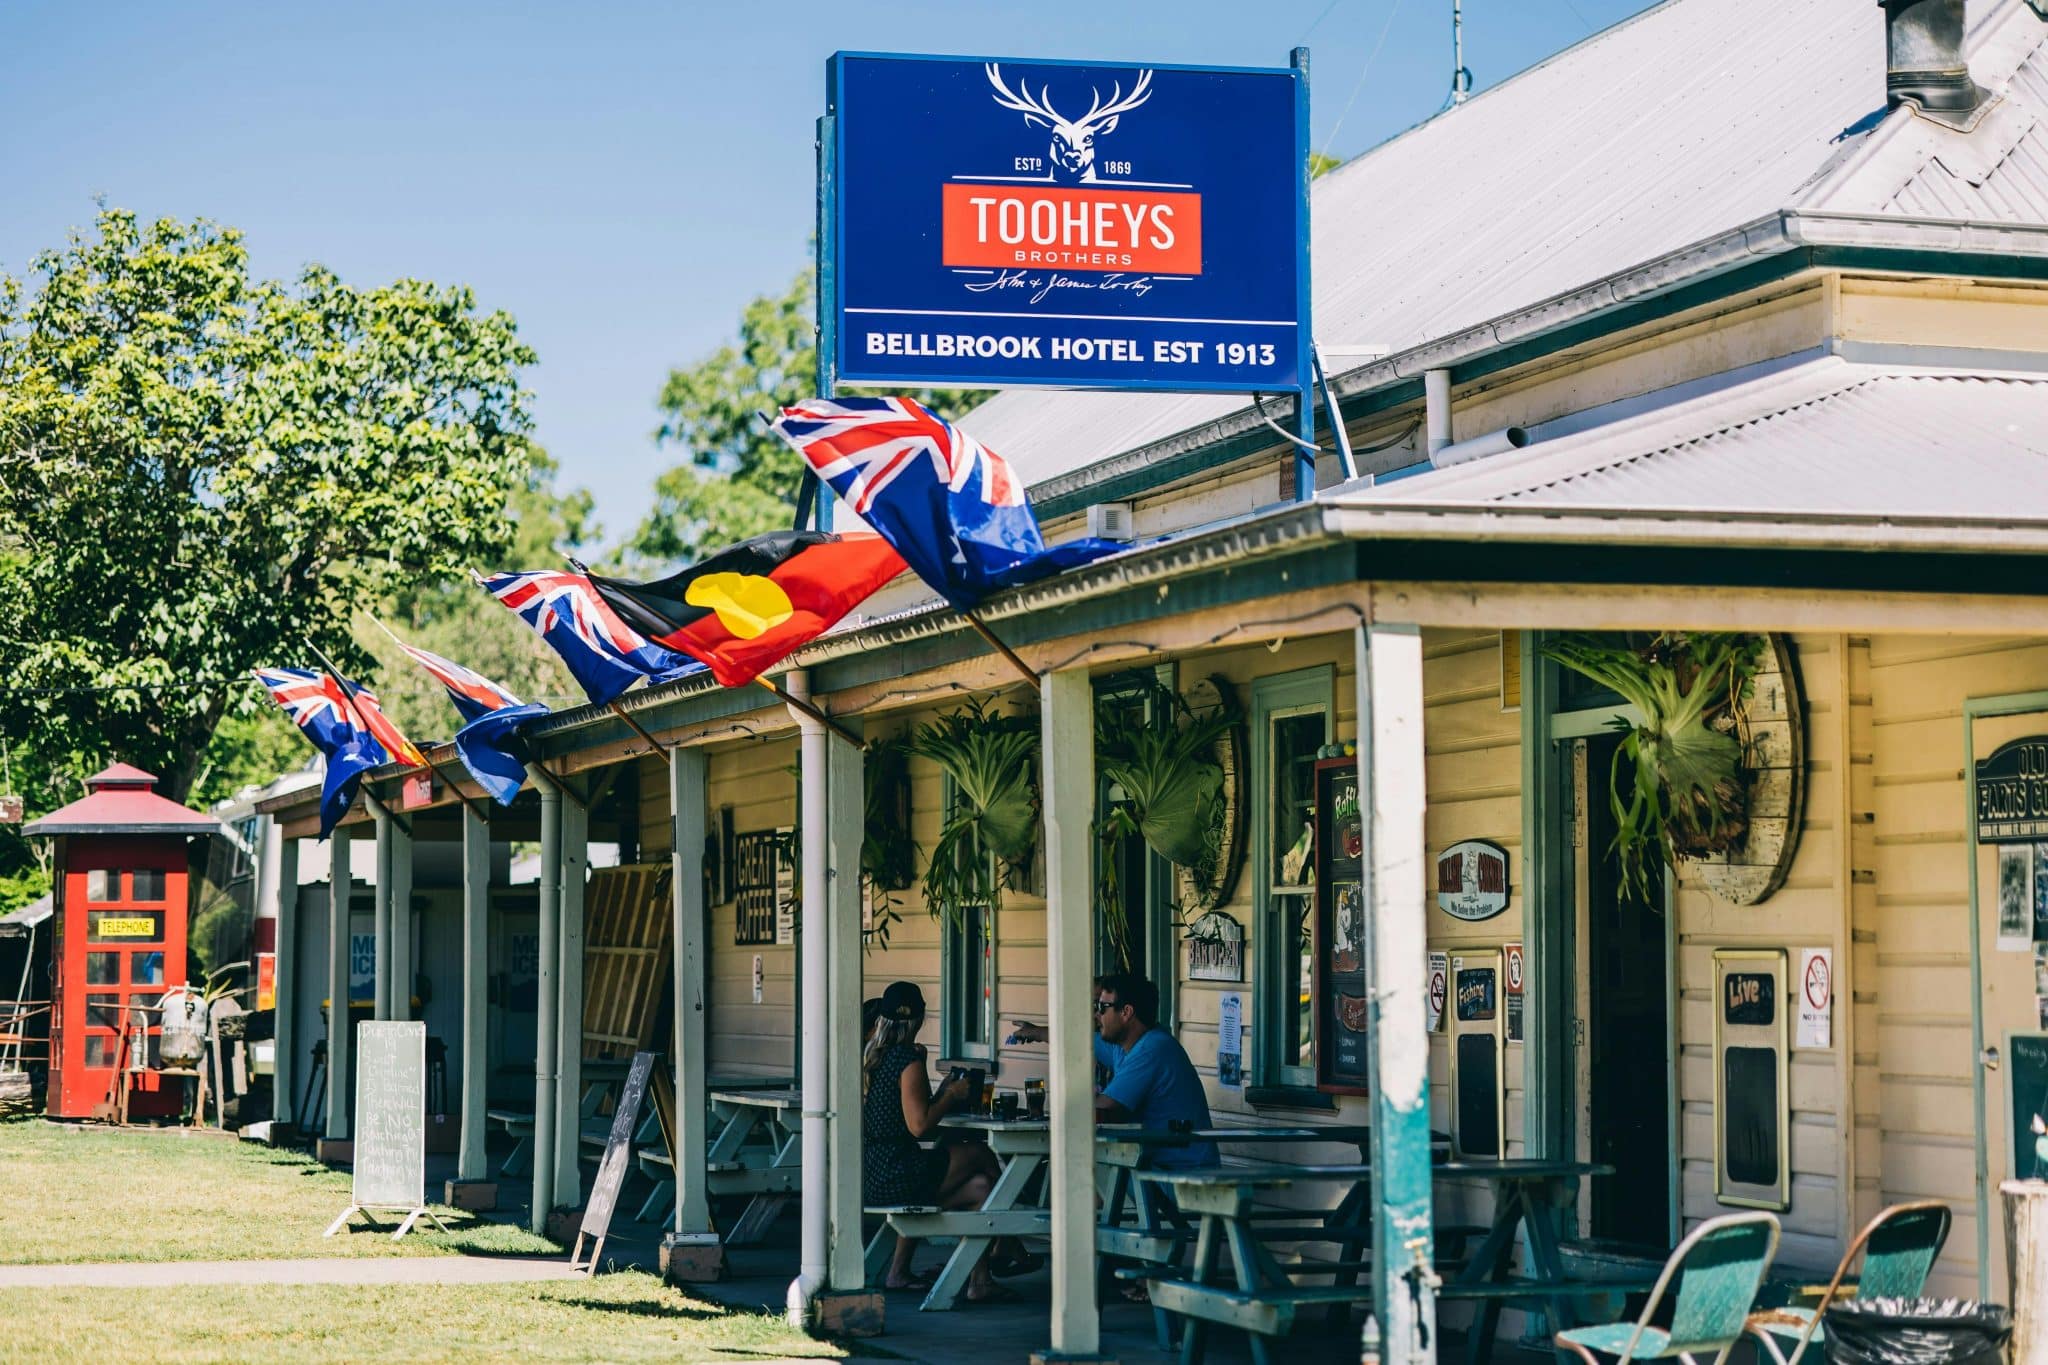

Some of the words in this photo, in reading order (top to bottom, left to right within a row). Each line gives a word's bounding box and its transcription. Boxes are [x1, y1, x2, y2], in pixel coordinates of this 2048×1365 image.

[1104, 161, 1131, 174] 1869
[970, 197, 1175, 250] TOOHEYS
[1015, 251, 1132, 265] BROTHERS
[964, 269, 1028, 292] John
[1030, 273, 1097, 304] James
[866, 333, 1041, 359] BELLBROOK
[1051, 338, 1144, 362] HOTEL
[1154, 341, 1204, 363] EST
[1216, 343, 1276, 366] 1913
[2019, 746, 2046, 779] OLD
[1979, 783, 2026, 819] FARTS
[2032, 781, 2048, 816] CO
[738, 835, 773, 886] GREAT
[103, 921, 150, 933] TELEPHONE
[736, 888, 772, 941] COFFEE
[1190, 942, 1207, 966] BAR
[1209, 943, 1239, 968] OPEN
[1459, 981, 1485, 1004] Fishing
[1729, 975, 1759, 1009] Live
